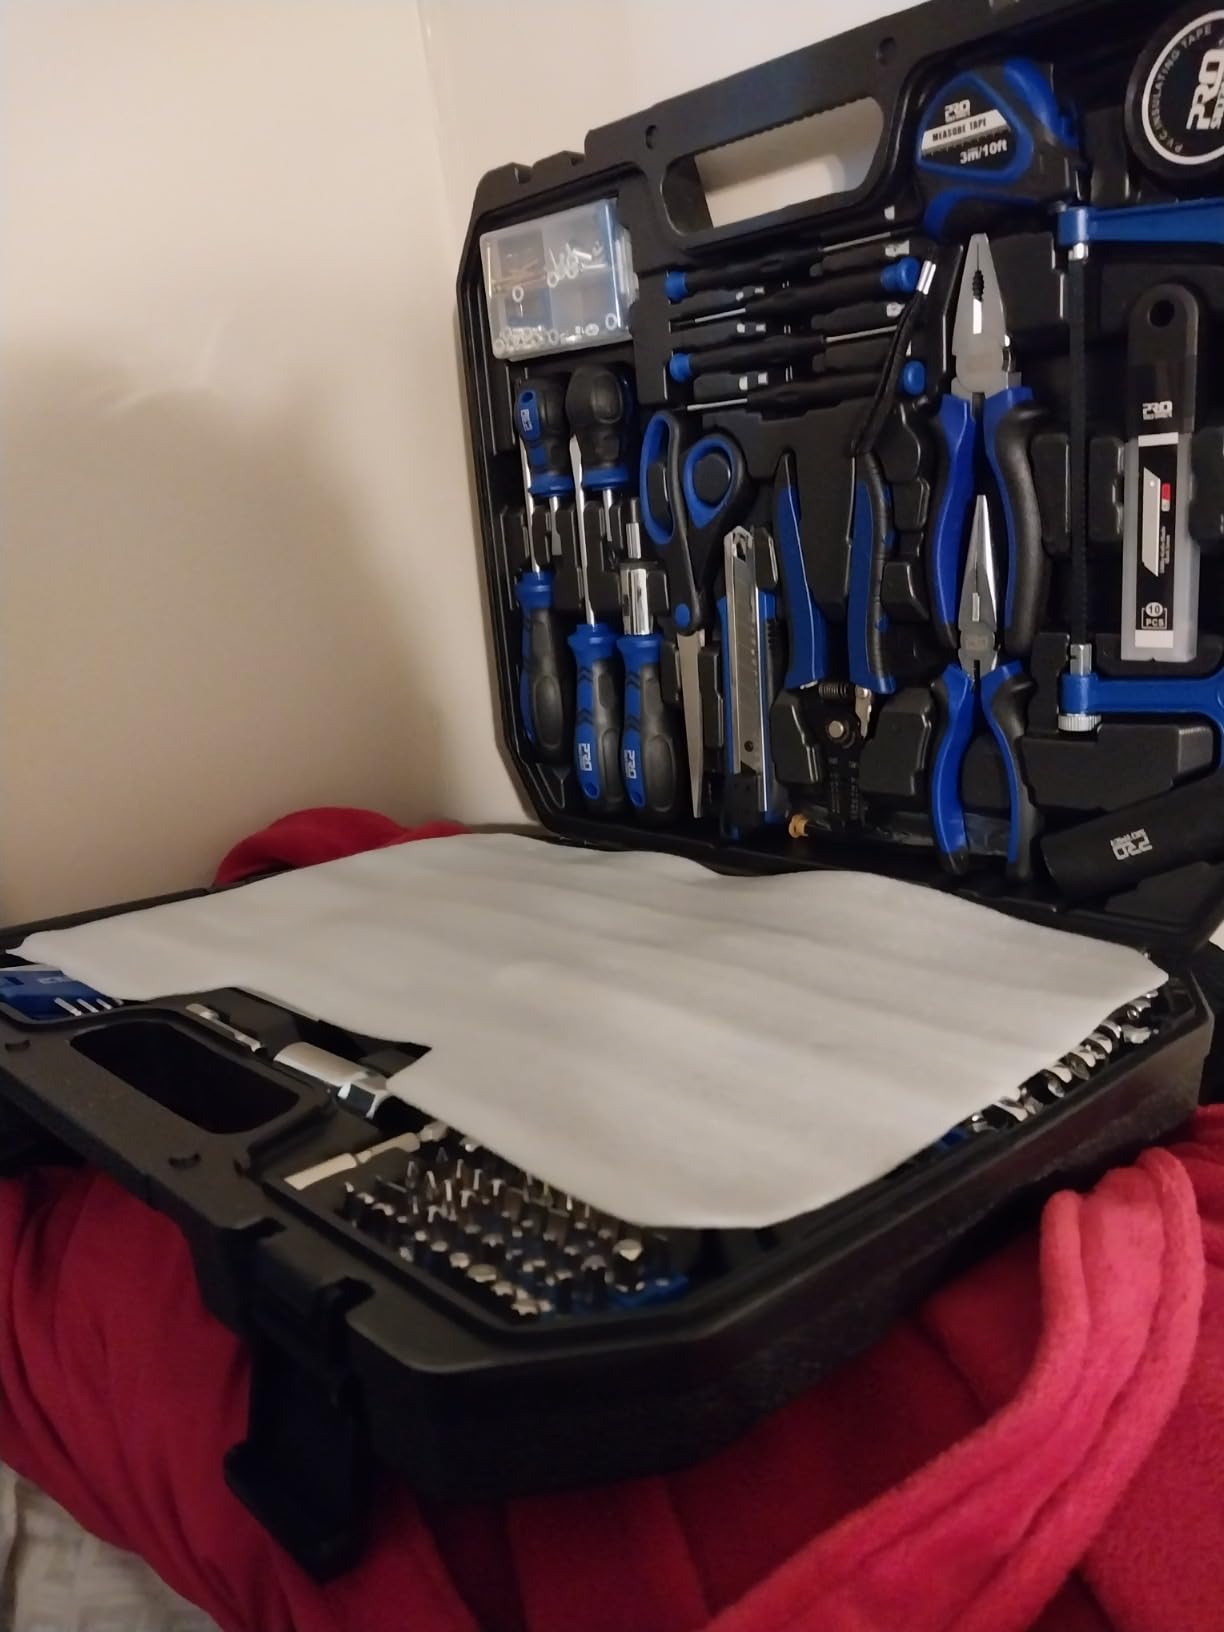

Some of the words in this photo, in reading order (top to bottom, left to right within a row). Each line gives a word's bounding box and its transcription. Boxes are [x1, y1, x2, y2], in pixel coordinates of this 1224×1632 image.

[1180, 23, 1212, 49] TAPE
[1186, 49, 1224, 129] PRO
[932, 124, 966, 142] MEASURE
[970, 117, 987, 130] TAPE
[960, 139, 1008, 164] 3m/10ft
[1148, 604, 1161, 615] 10
[1145, 618, 1164, 627] PCS
